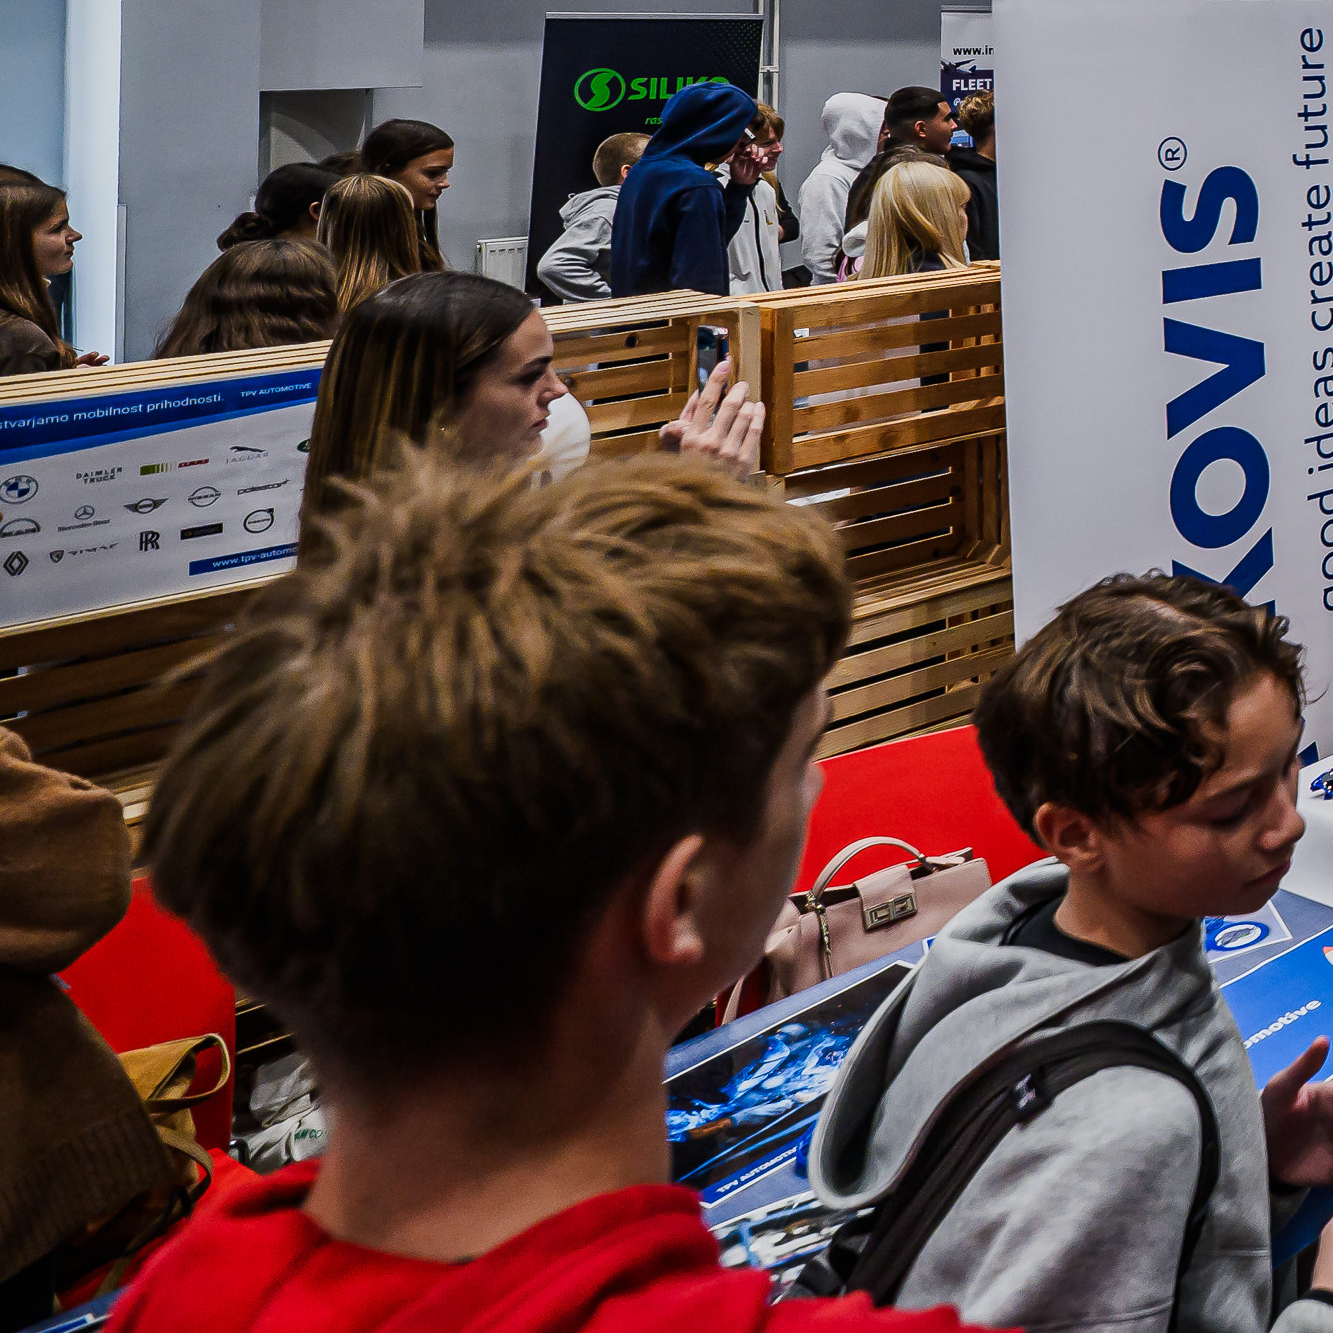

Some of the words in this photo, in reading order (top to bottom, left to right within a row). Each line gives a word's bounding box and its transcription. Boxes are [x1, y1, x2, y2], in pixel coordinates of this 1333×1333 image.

[952, 78, 993, 91] FLEET
[1292, 27, 1330, 170] future
[258, 382, 313, 395] AUTOMOTIVE
[73, 403, 143, 421] mobilnost
[146, 393, 225, 413] prihodnosti.
[75, 466, 123, 480] DAIMLER
[83, 475, 116, 485] TRUCK
